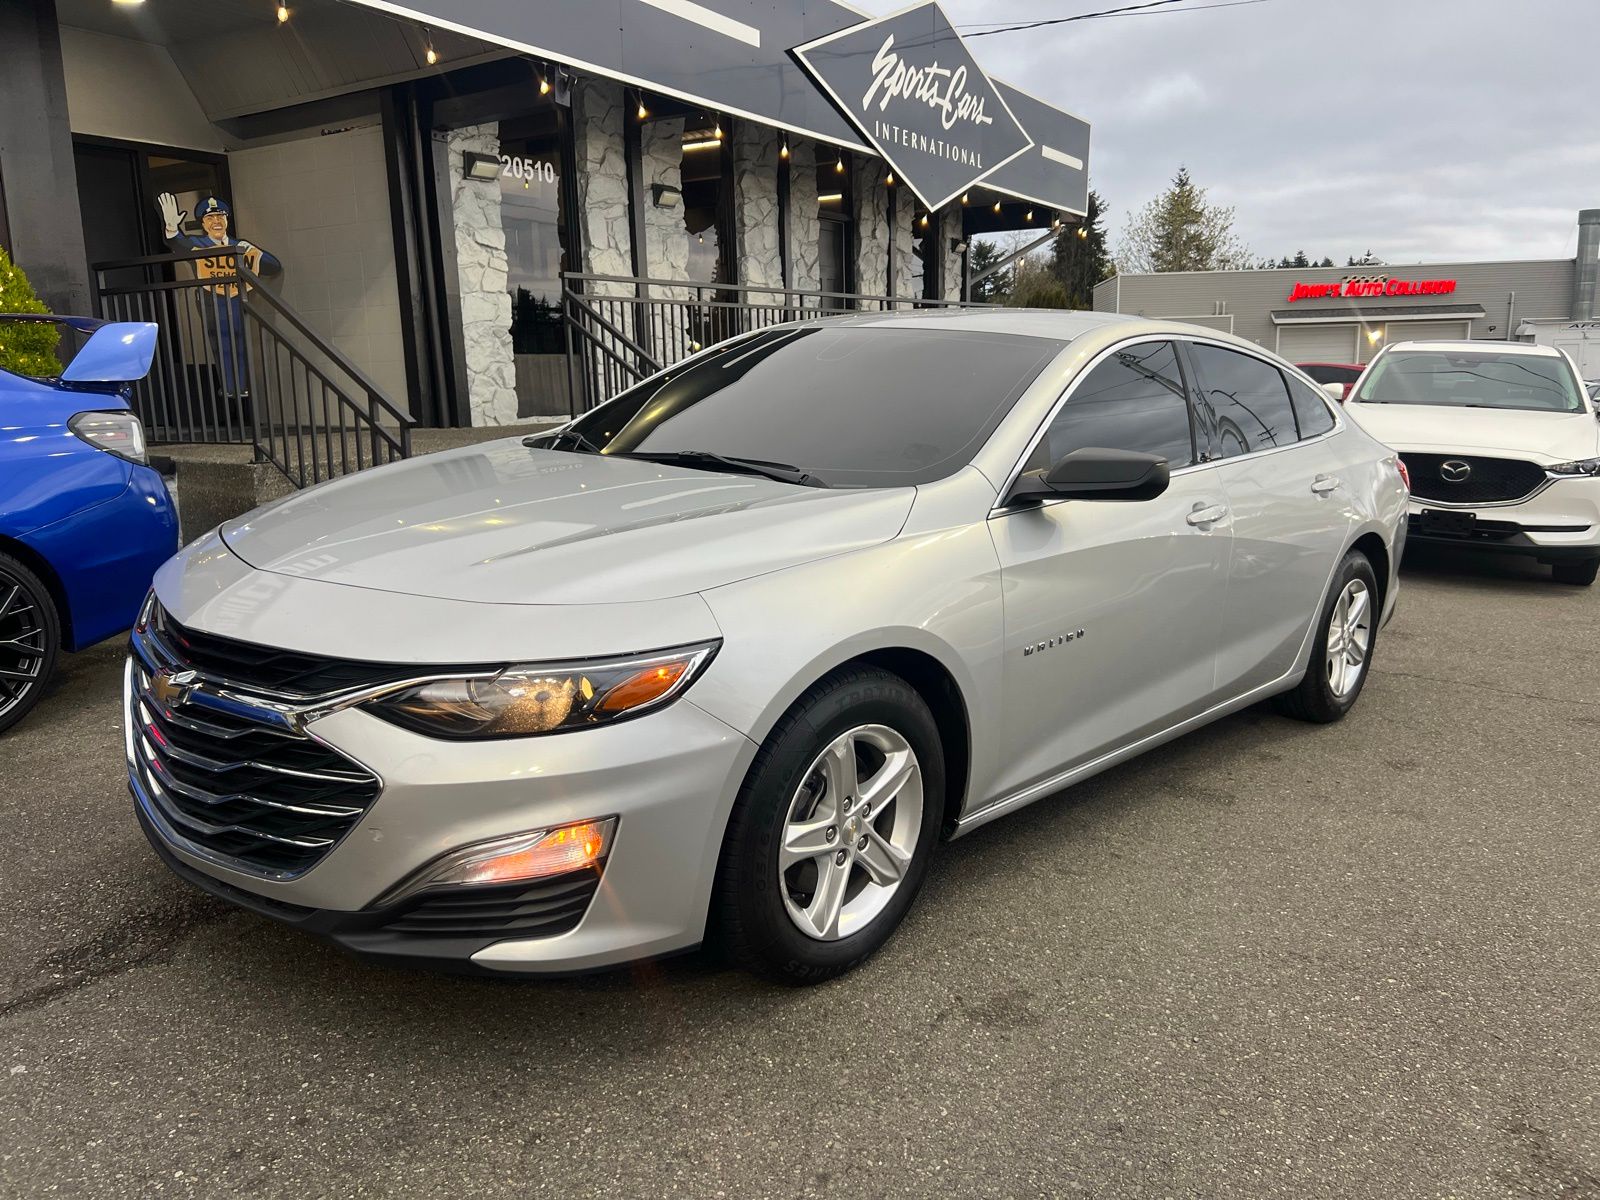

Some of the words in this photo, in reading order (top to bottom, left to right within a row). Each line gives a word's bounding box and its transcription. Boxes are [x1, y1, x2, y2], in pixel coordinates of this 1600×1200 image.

[862, 33, 950, 111] Sports
[942, 65, 993, 130] Cars
[875, 120, 983, 169] INTERNATIONAL
[501, 154, 554, 184] 20510
[1344, 280, 1384, 297] AUTO
[1385, 279, 1457, 296] COLLISION
